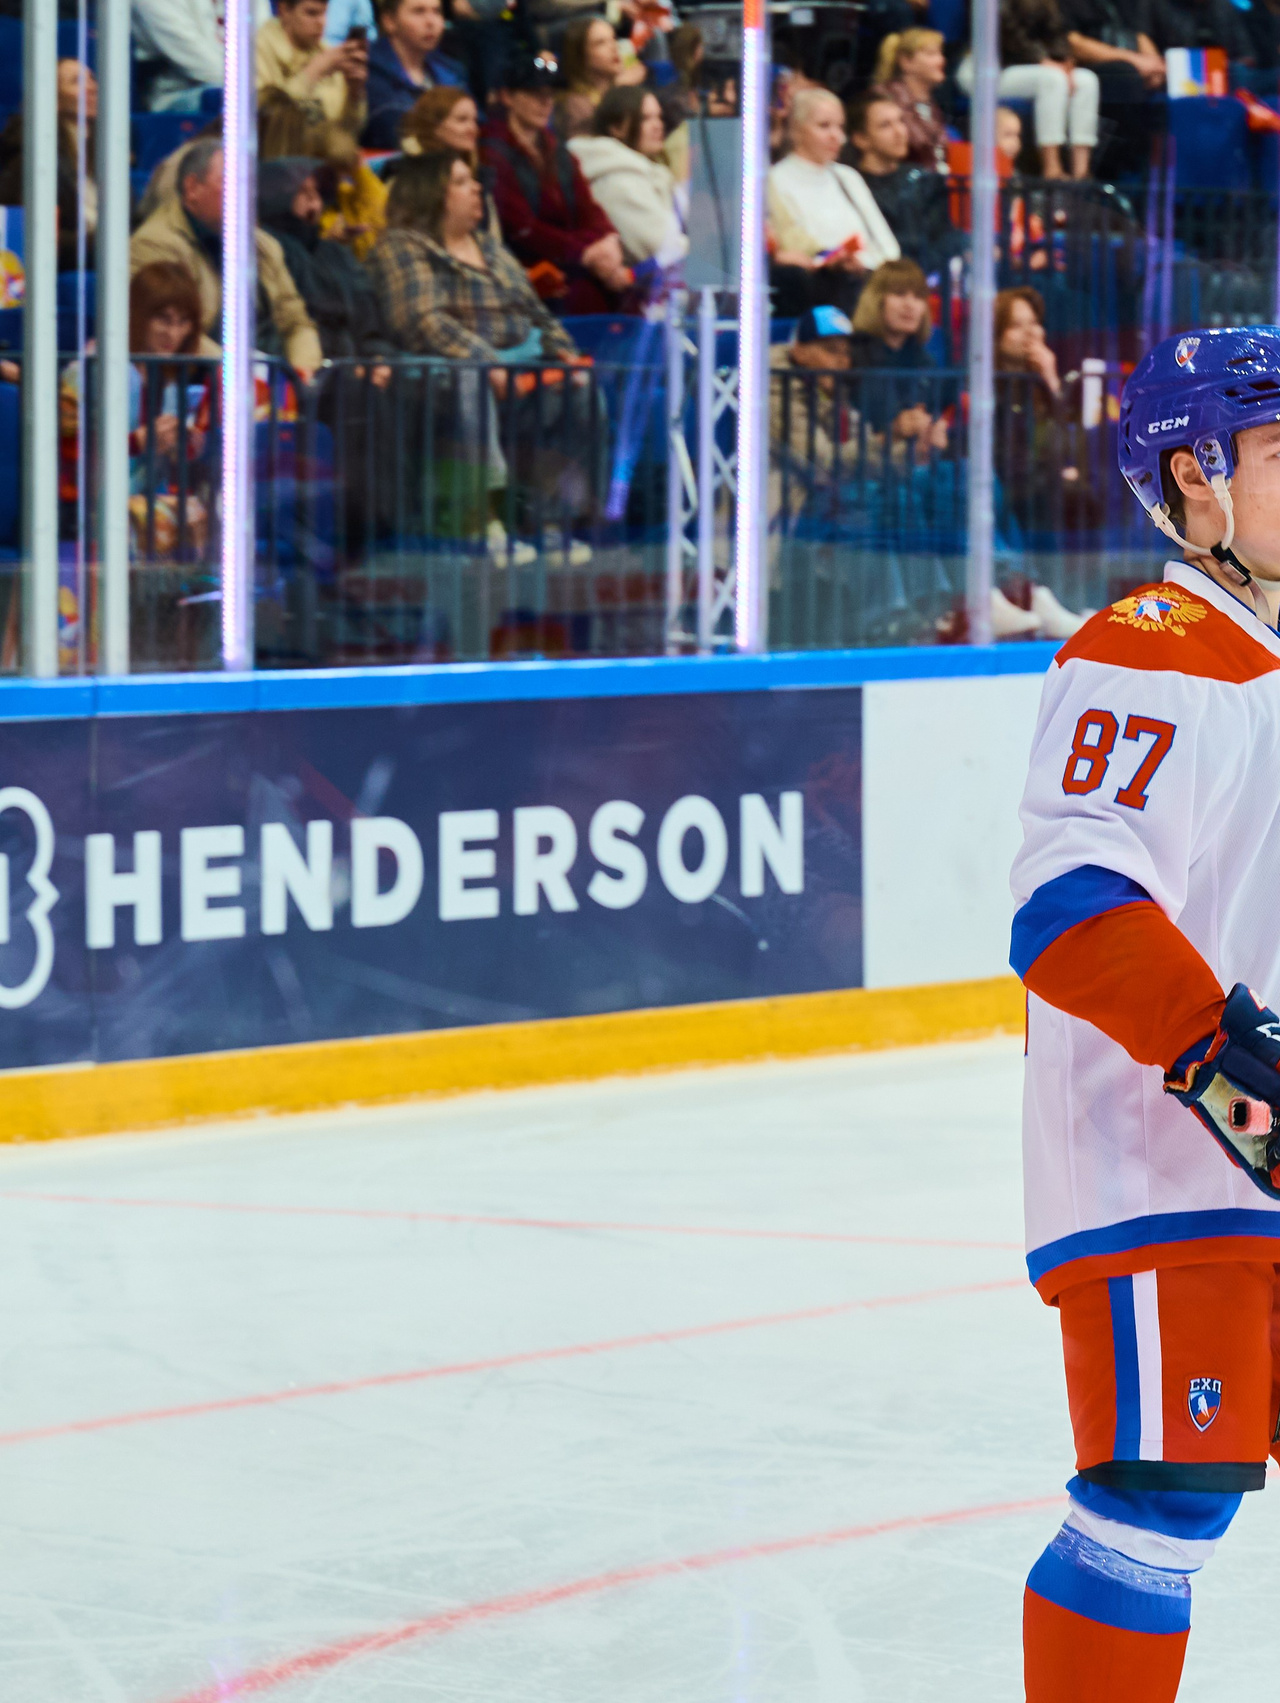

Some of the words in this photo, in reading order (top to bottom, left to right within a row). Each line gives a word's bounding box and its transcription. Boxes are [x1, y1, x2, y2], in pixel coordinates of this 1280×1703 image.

[1148, 415, 1189, 434] CCM
[1062, 708, 1177, 811] 87
[85, 790, 804, 949] HENDERSON
